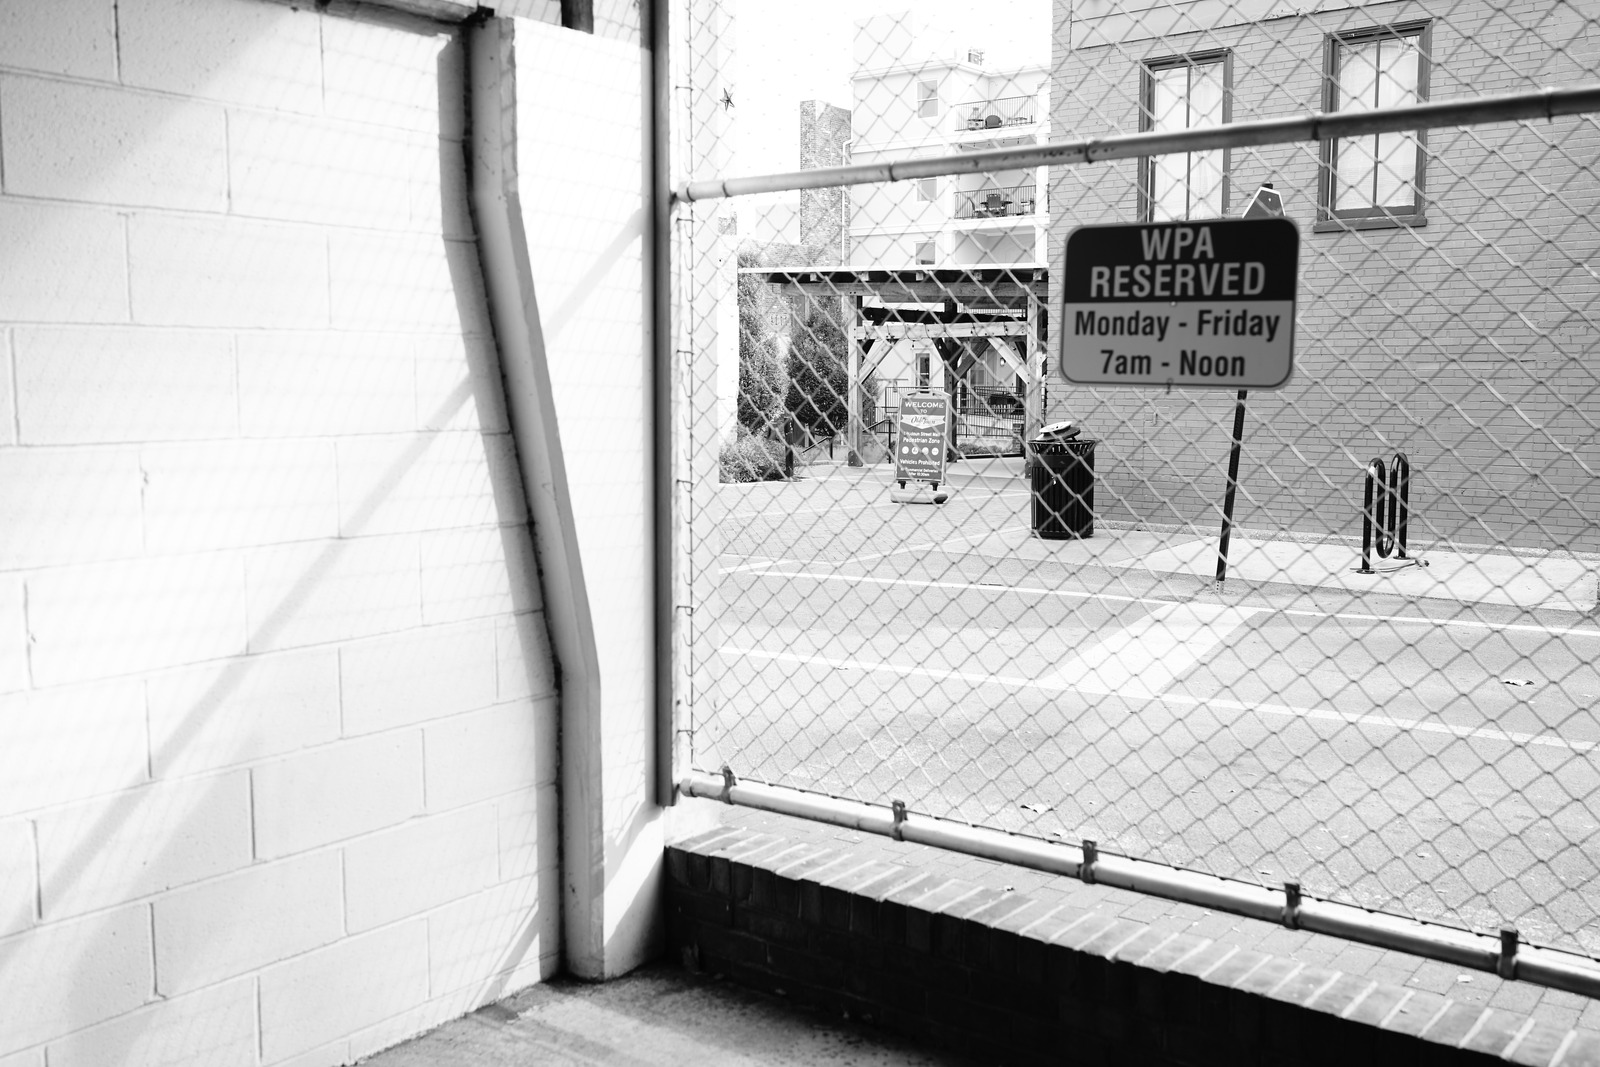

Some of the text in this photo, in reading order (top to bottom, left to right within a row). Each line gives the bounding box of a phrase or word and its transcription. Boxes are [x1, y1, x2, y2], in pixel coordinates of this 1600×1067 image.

[1141, 226, 1214, 261] WPA
[1090, 261, 1266, 298] RESERVED
[1074, 310, 1170, 342] Monday
[1197, 309, 1281, 343] Friday
[1100, 350, 1151, 375] 7am
[1180, 349, 1246, 377] Noon
